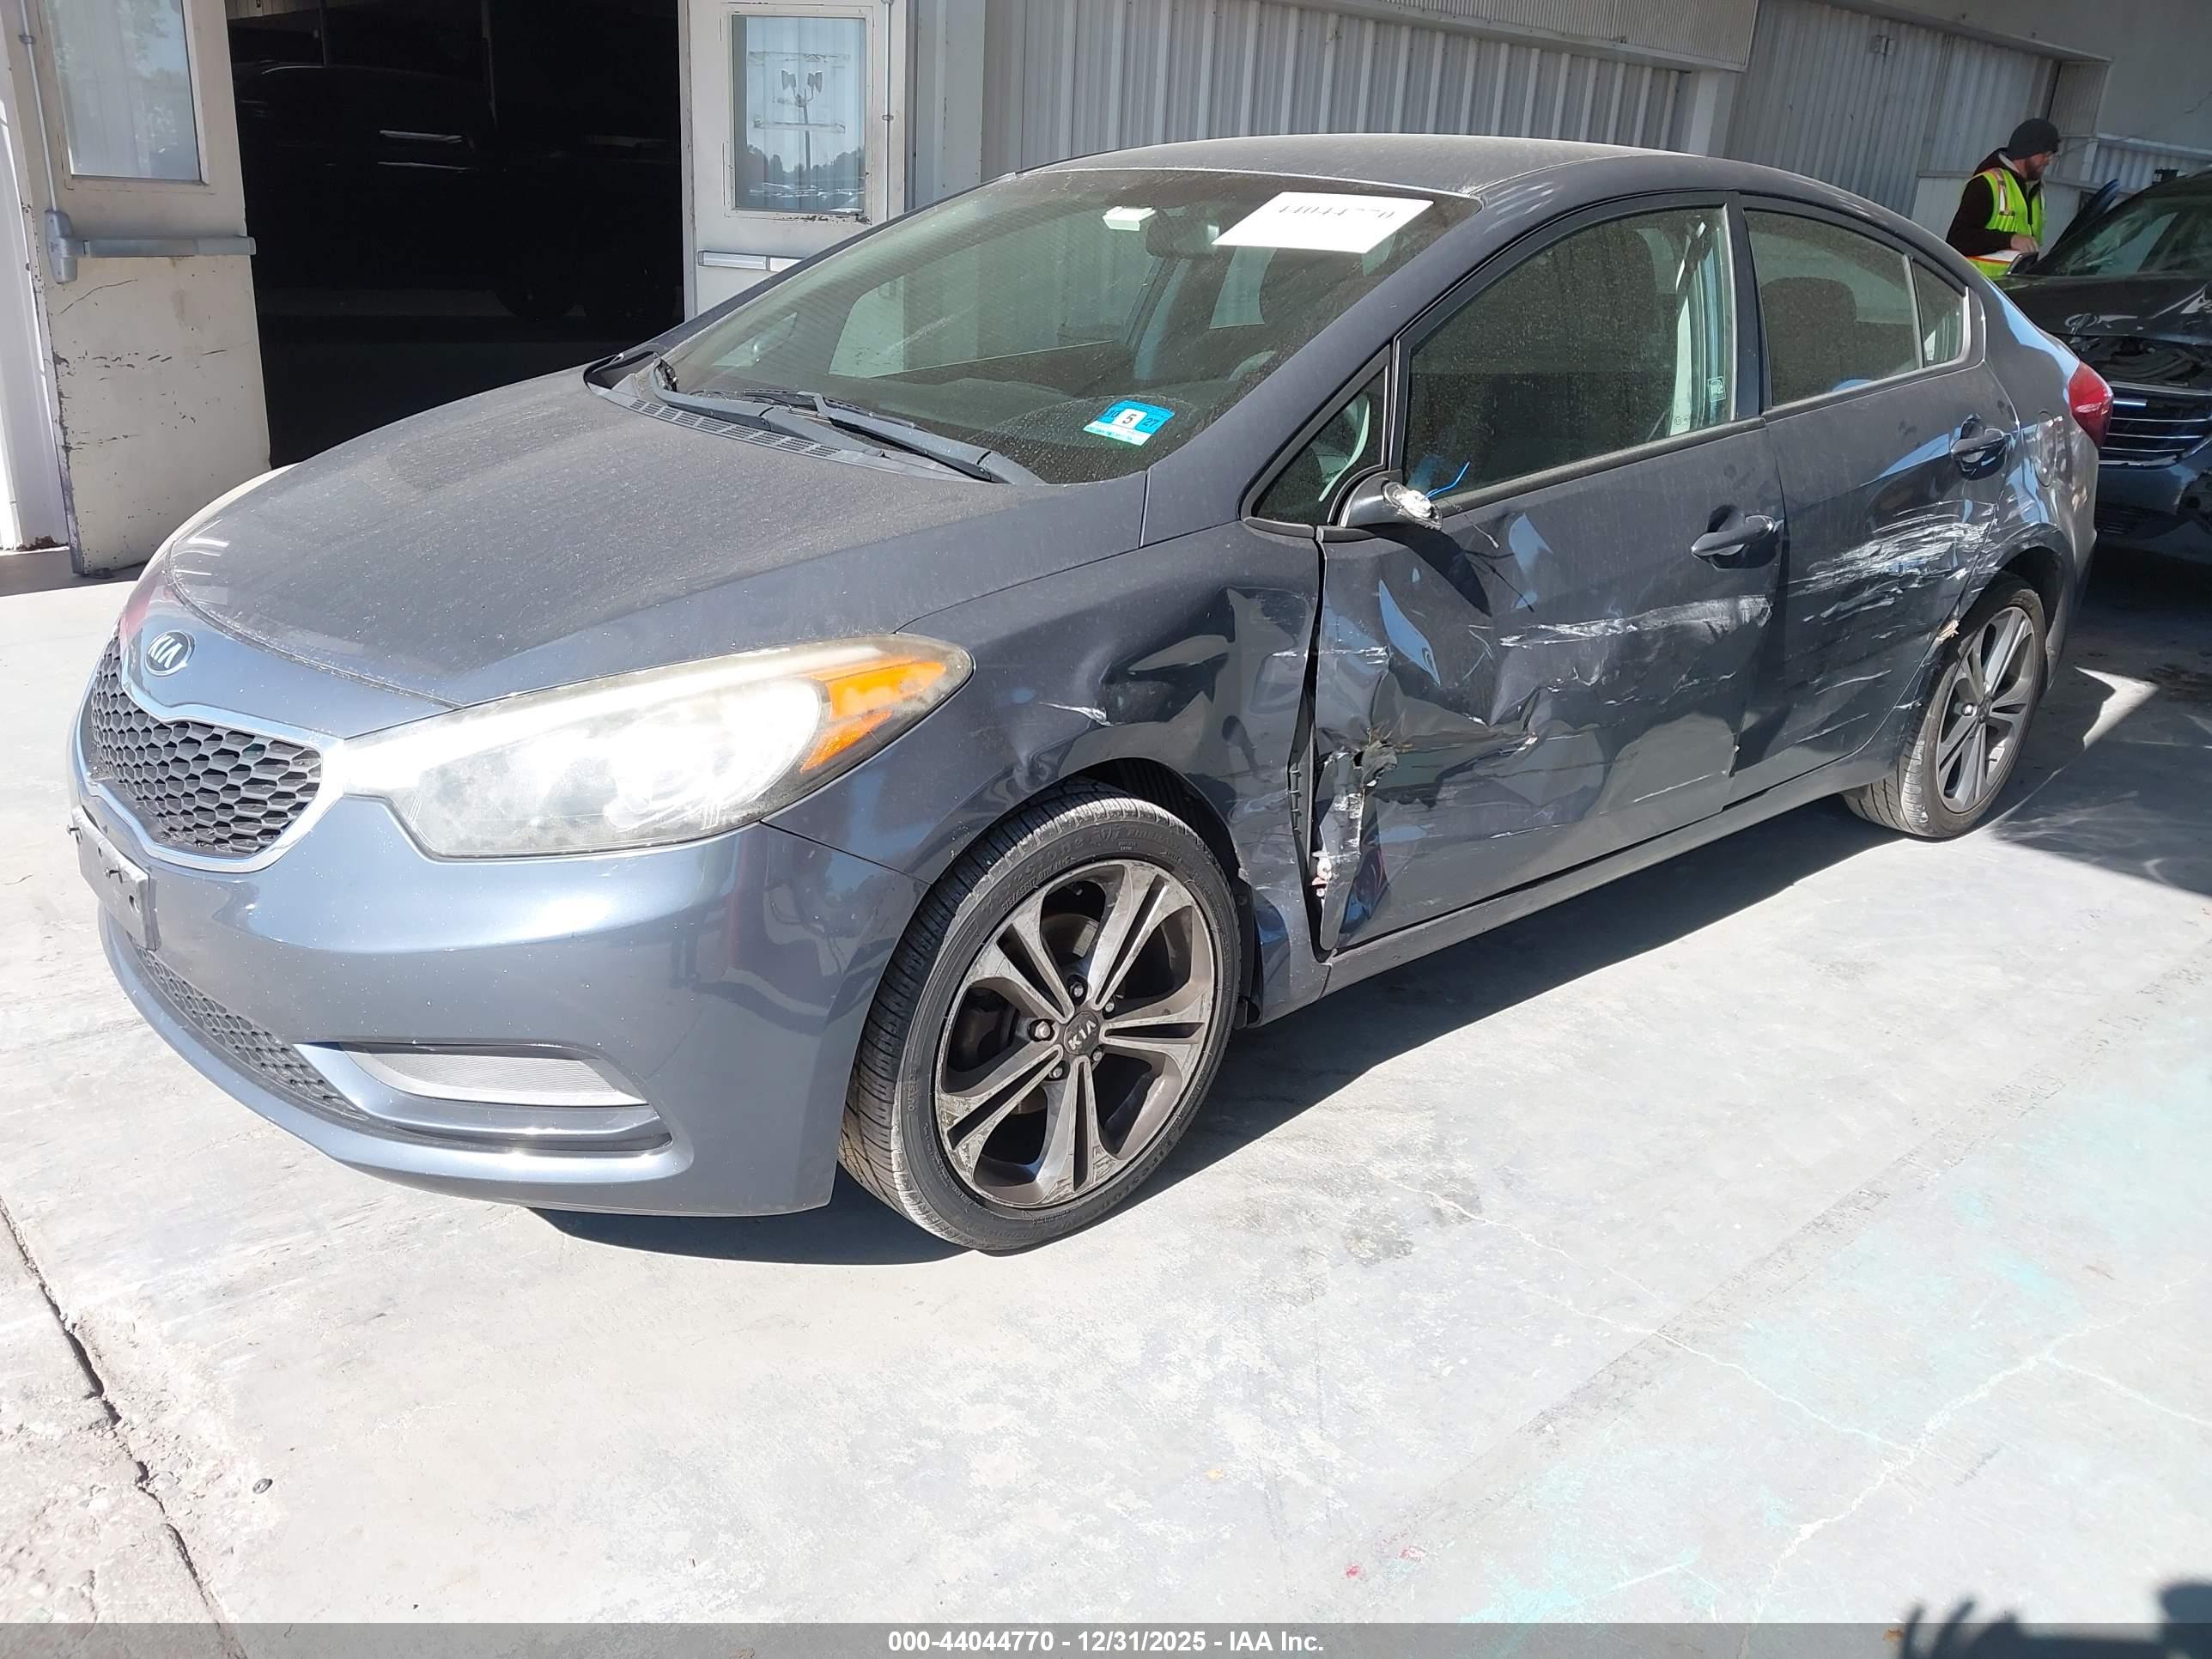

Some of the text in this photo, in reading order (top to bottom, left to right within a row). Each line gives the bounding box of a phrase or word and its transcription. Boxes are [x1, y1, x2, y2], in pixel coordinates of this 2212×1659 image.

[1122, 413, 1137, 424] 5
[1143, 417, 1158, 428] 27
[148, 635, 183, 669] KIA
[1067, 1020, 1097, 1051] KIA
[907, 1066, 920, 1113] OUTSIDE
